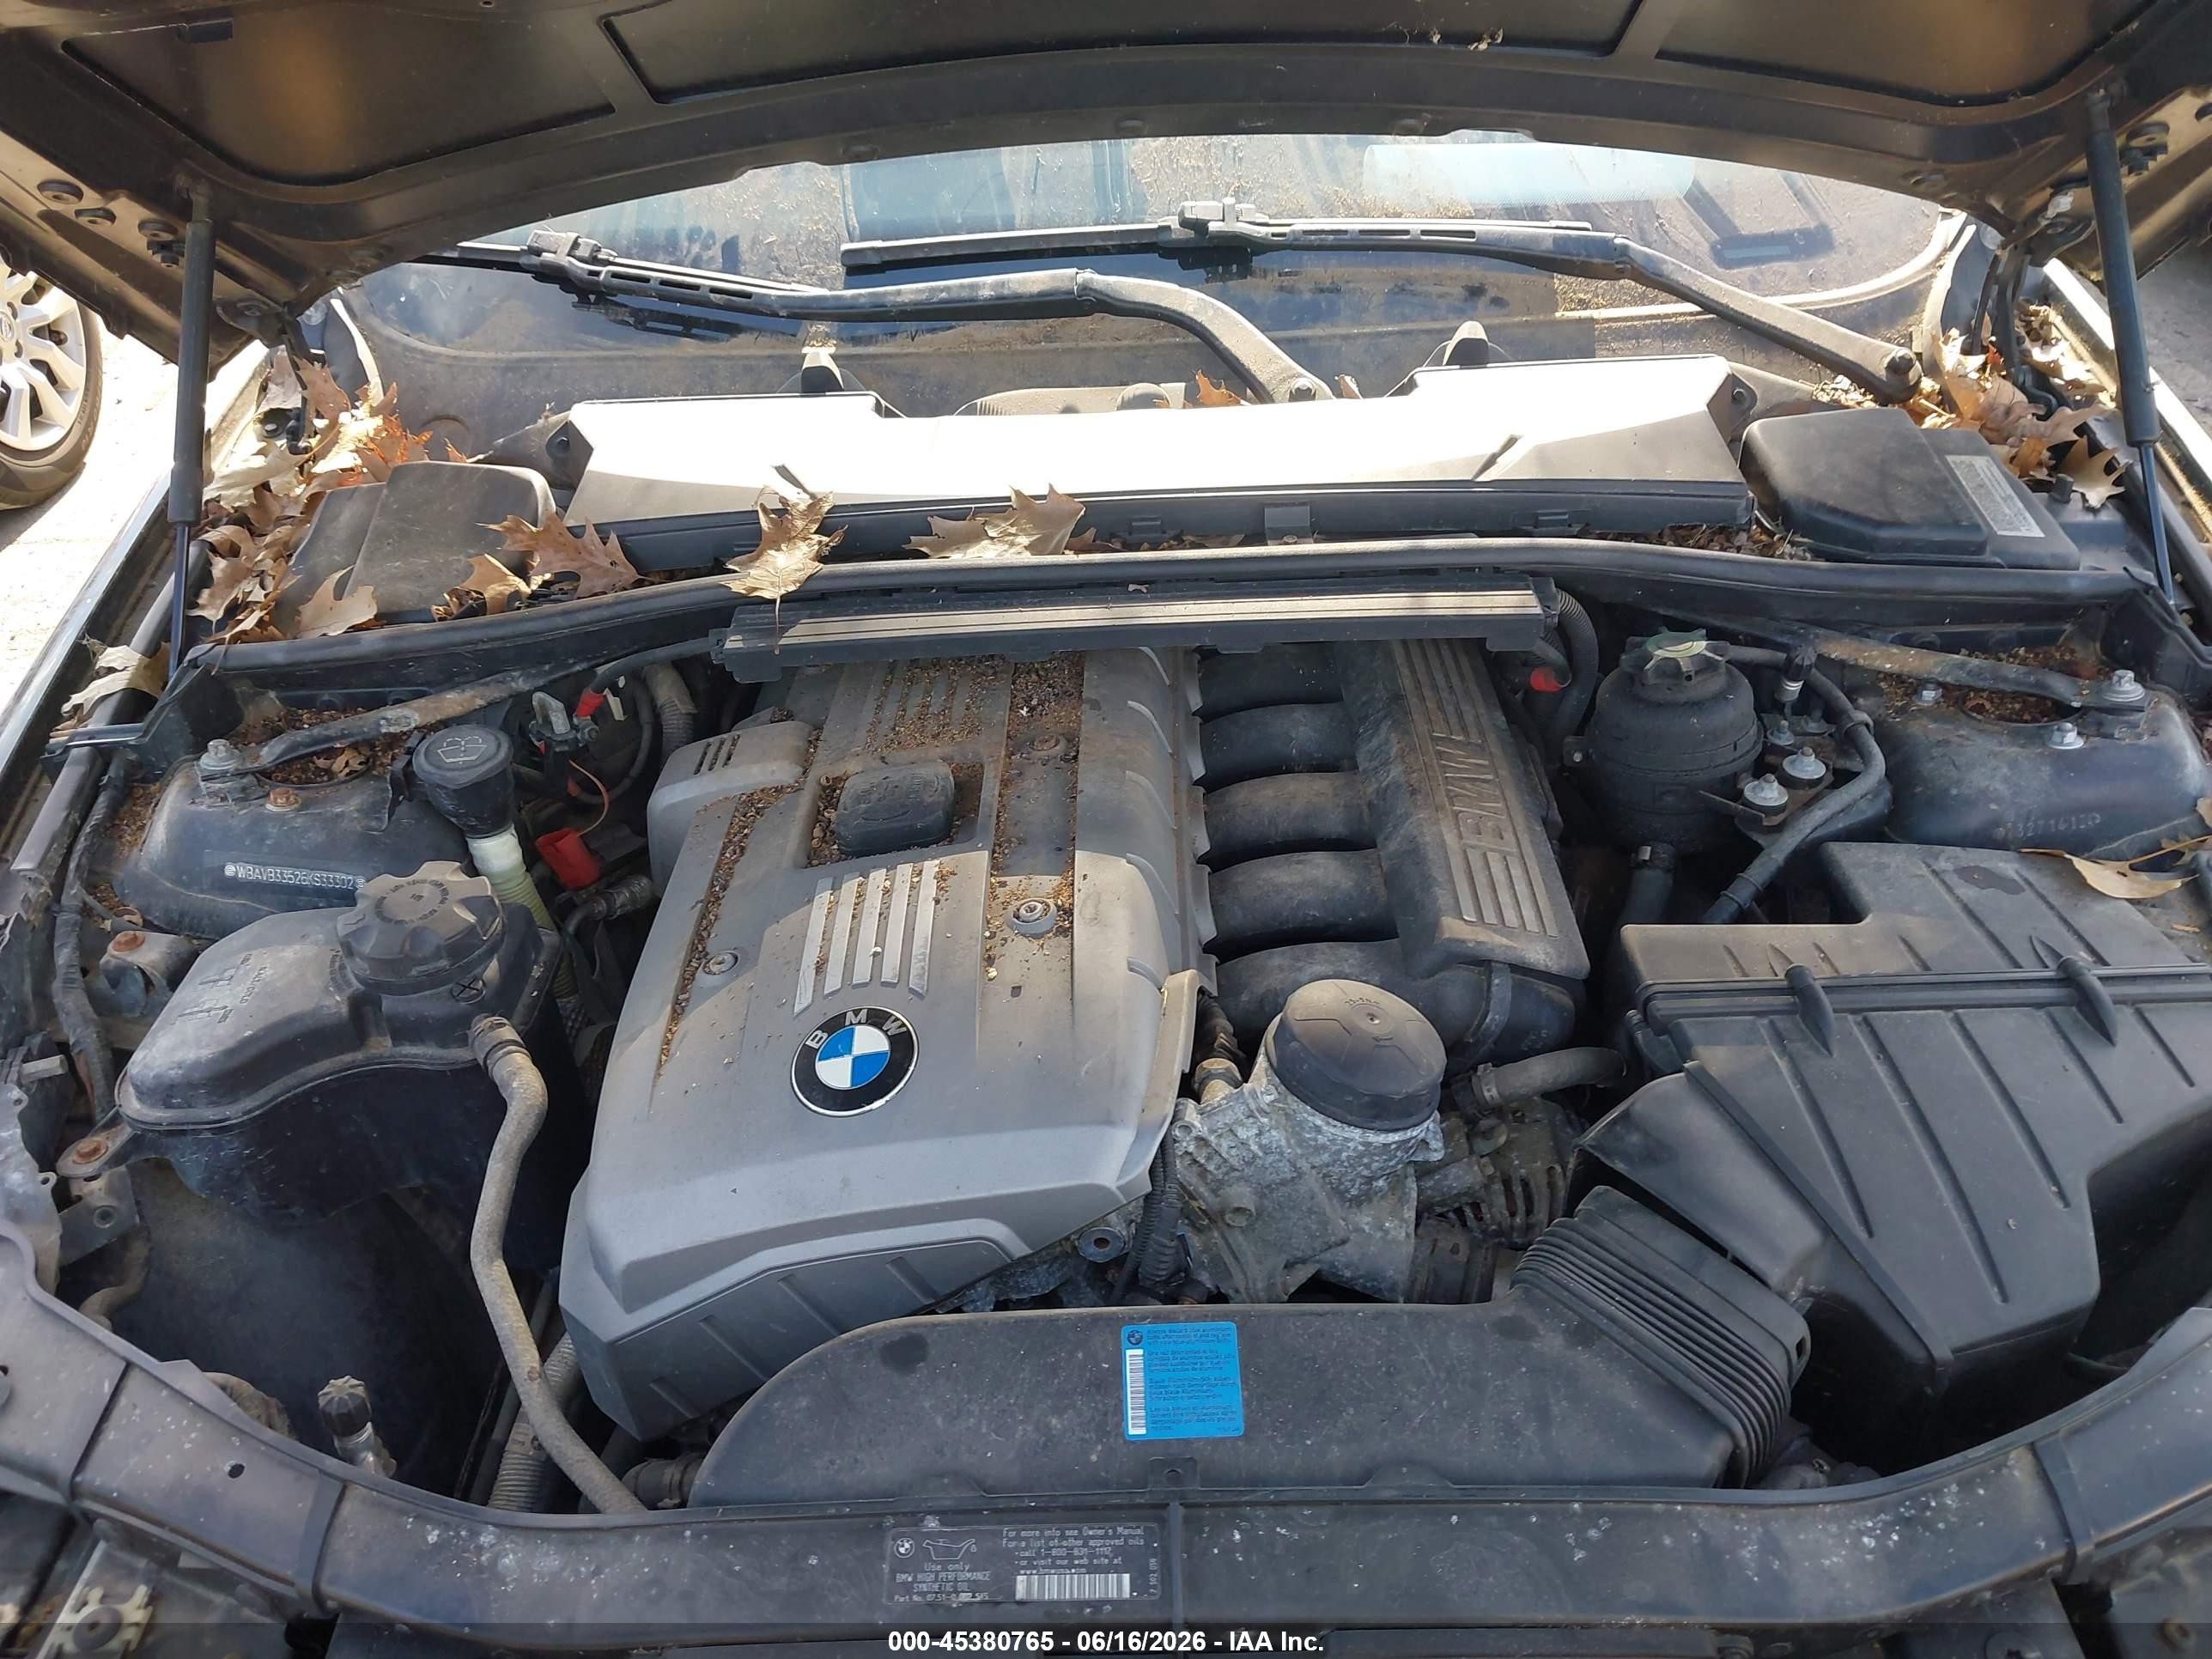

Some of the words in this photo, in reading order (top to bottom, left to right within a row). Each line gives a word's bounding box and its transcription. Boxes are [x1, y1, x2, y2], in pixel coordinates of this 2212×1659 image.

[805, 1008, 908, 1049] BMW
[1003, 1528, 1016, 1537] For
[1044, 1528, 1061, 1537] info
[1082, 1527, 1113, 1536] Owner's
[1116, 1526, 1145, 1535] Manual
[1003, 1538, 1017, 1547] For
[1030, 1538, 1045, 1547] list
[1088, 1537, 1124, 1547] approved
[1128, 1537, 1145, 1546] oils
[1113, 1556, 1122, 1565] at
[924, 1562, 942, 1571] Use
[948, 1562, 970, 1572] only
[896, 1572, 914, 1583] BMW
[916, 1572, 935, 1582] HIGH
[938, 1571, 991, 1581] PERFORMANCE
[913, 1582, 954, 1592] SYNTHETIC
[957, 1582, 969, 1591] OIL
[894, 1594, 909, 1602] Part
